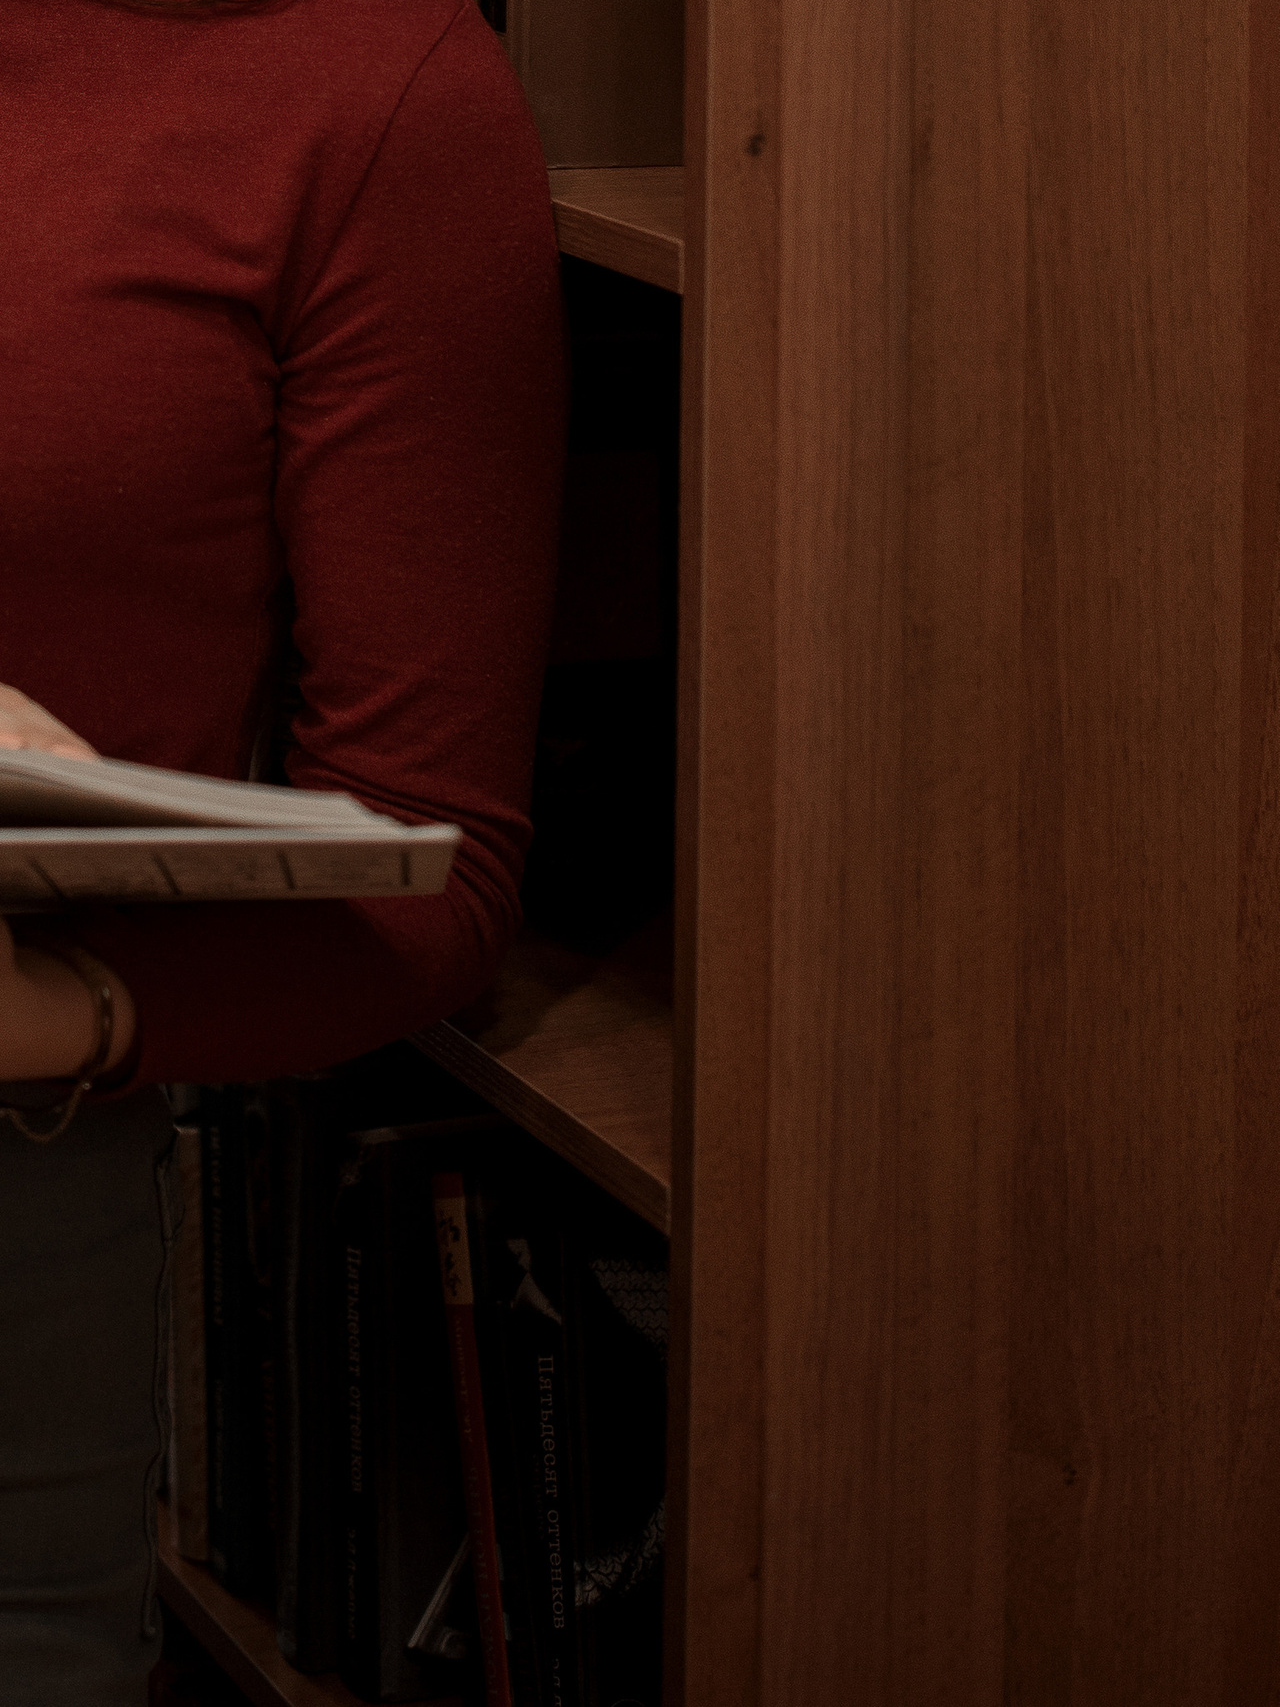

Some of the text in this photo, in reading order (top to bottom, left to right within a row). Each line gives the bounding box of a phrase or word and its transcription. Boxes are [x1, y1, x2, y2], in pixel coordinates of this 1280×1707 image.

[345, 1243, 364, 1495] Пятьдесят оттенков
[536, 1353, 561, 1499] Пятьдесят
[545, 1507, 567, 1631] оттенков
